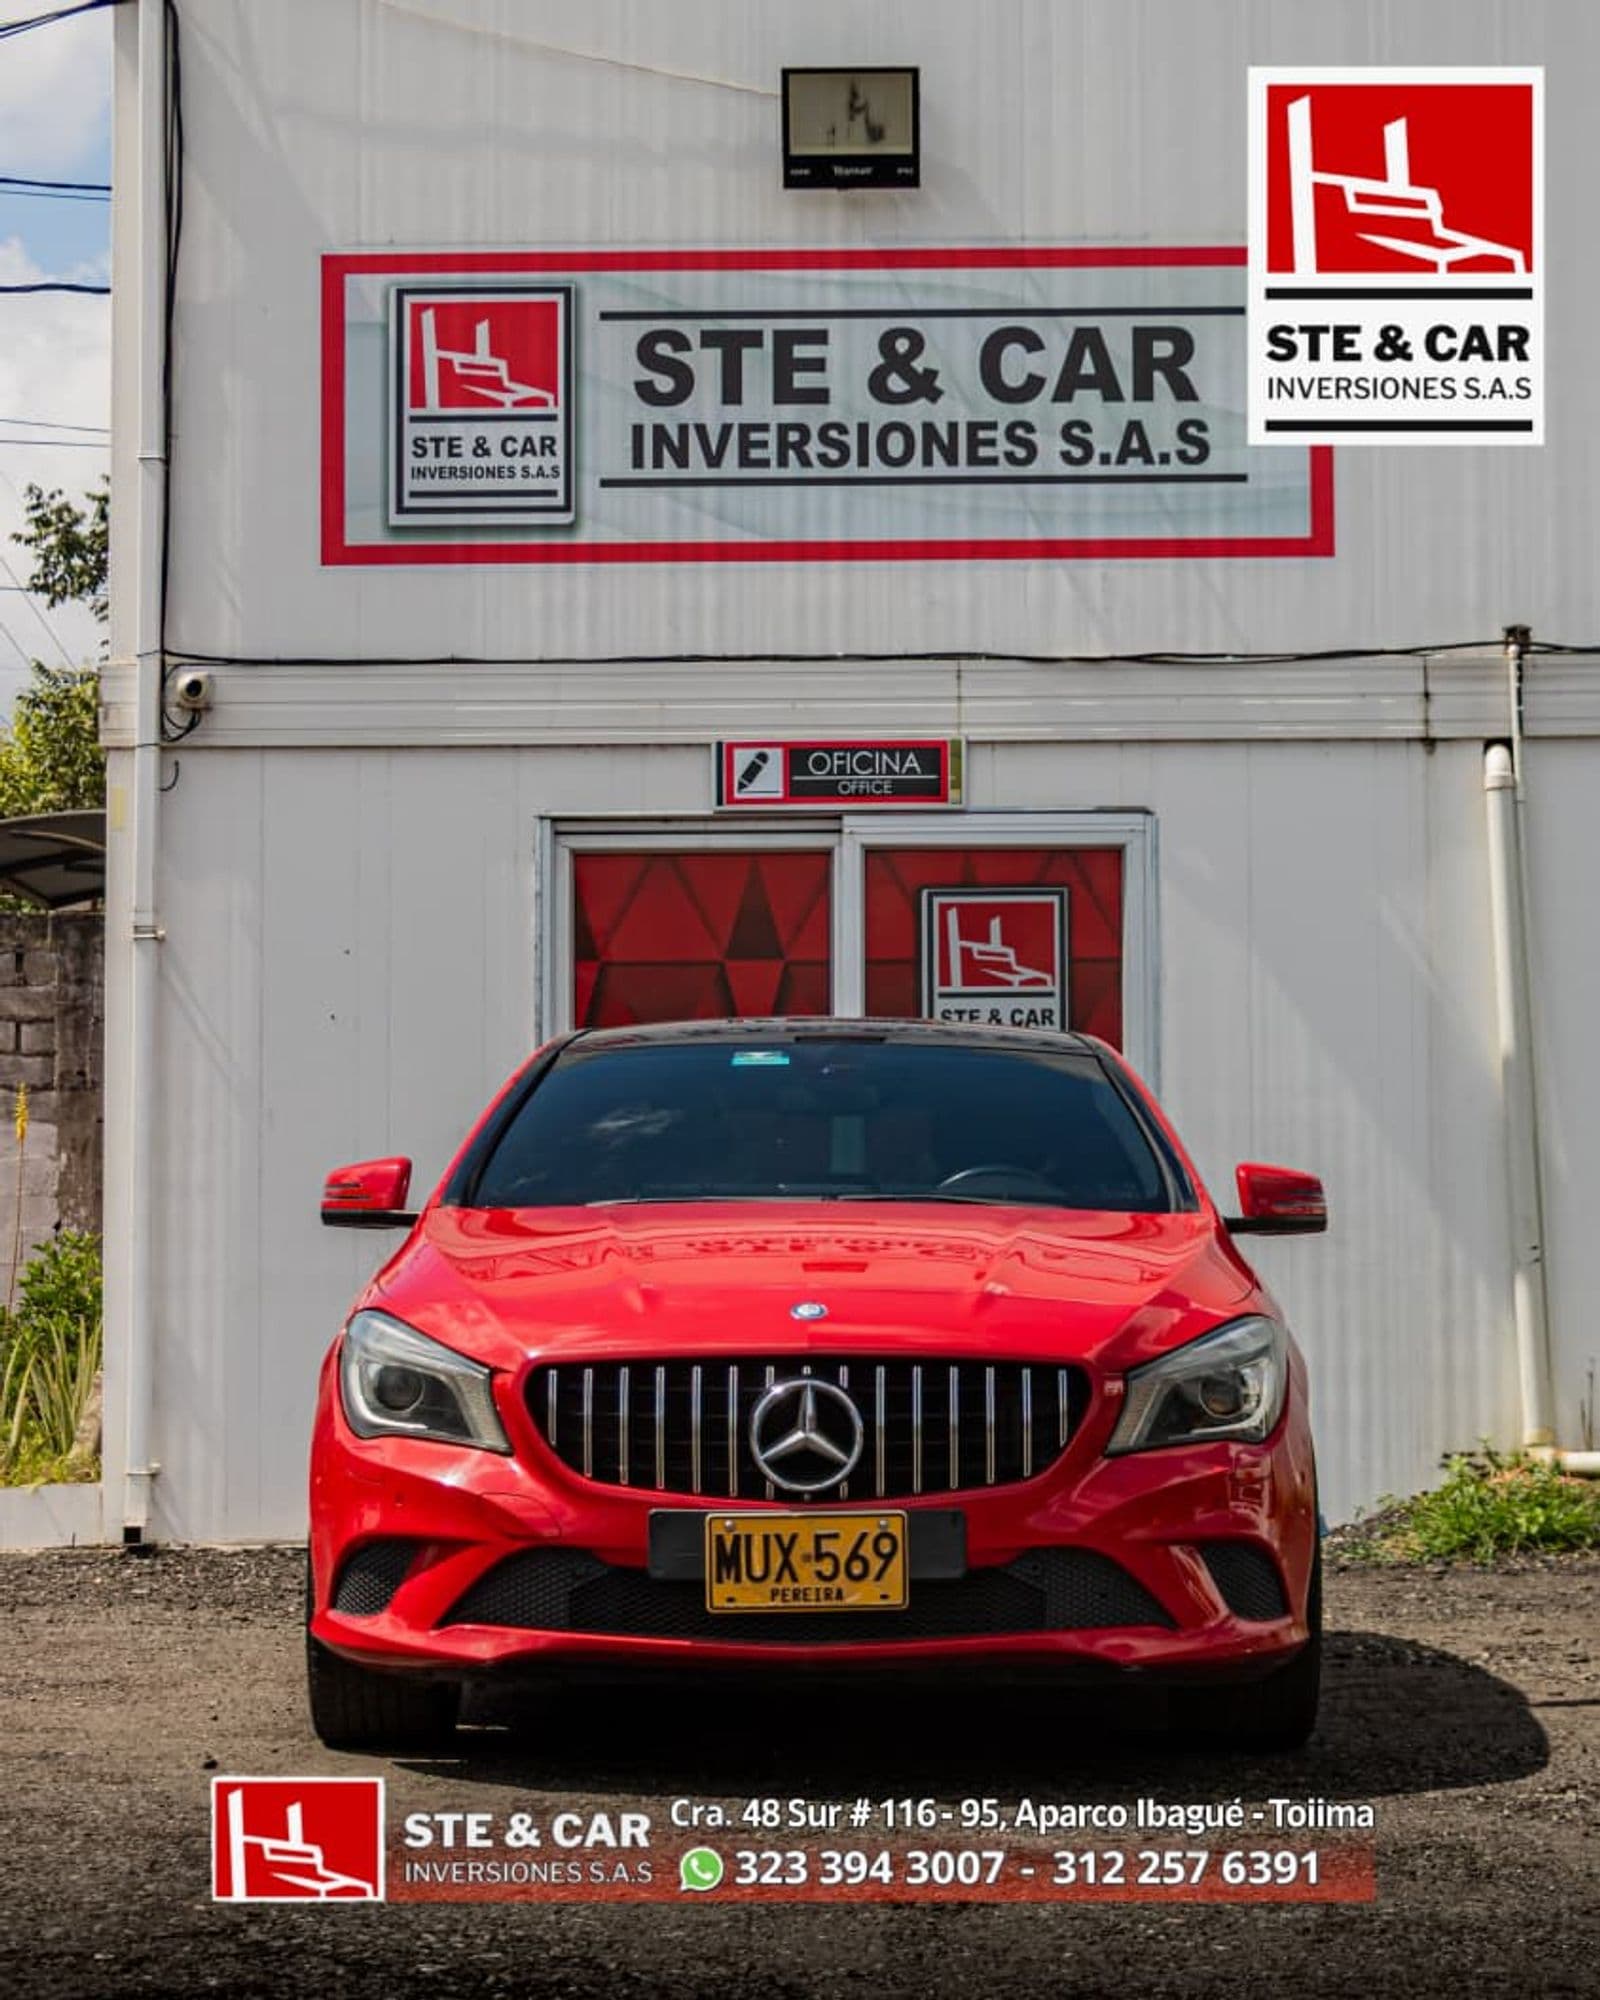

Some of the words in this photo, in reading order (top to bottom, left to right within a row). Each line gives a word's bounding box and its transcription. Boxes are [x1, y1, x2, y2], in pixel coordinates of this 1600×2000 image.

[634, 328, 830, 407] STE
[867, 327, 945, 406] &
[979, 326, 1200, 405] CAR
[411, 436, 463, 459] STE
[471, 435, 492, 458] &
[500, 435, 558, 458] CAR
[631, 420, 1038, 471] INVERSIONES
[1059, 418, 1211, 466] S.A.S
[410, 465, 517, 481] INVERSIONES
[520, 464, 561, 480] S.A.S
[808, 750, 922, 775] OFICINA
[837, 780, 894, 795] OFFICE
[1010, 1008, 1055, 1027] CAR
[770, 1586, 844, 1603] PEREIRA
